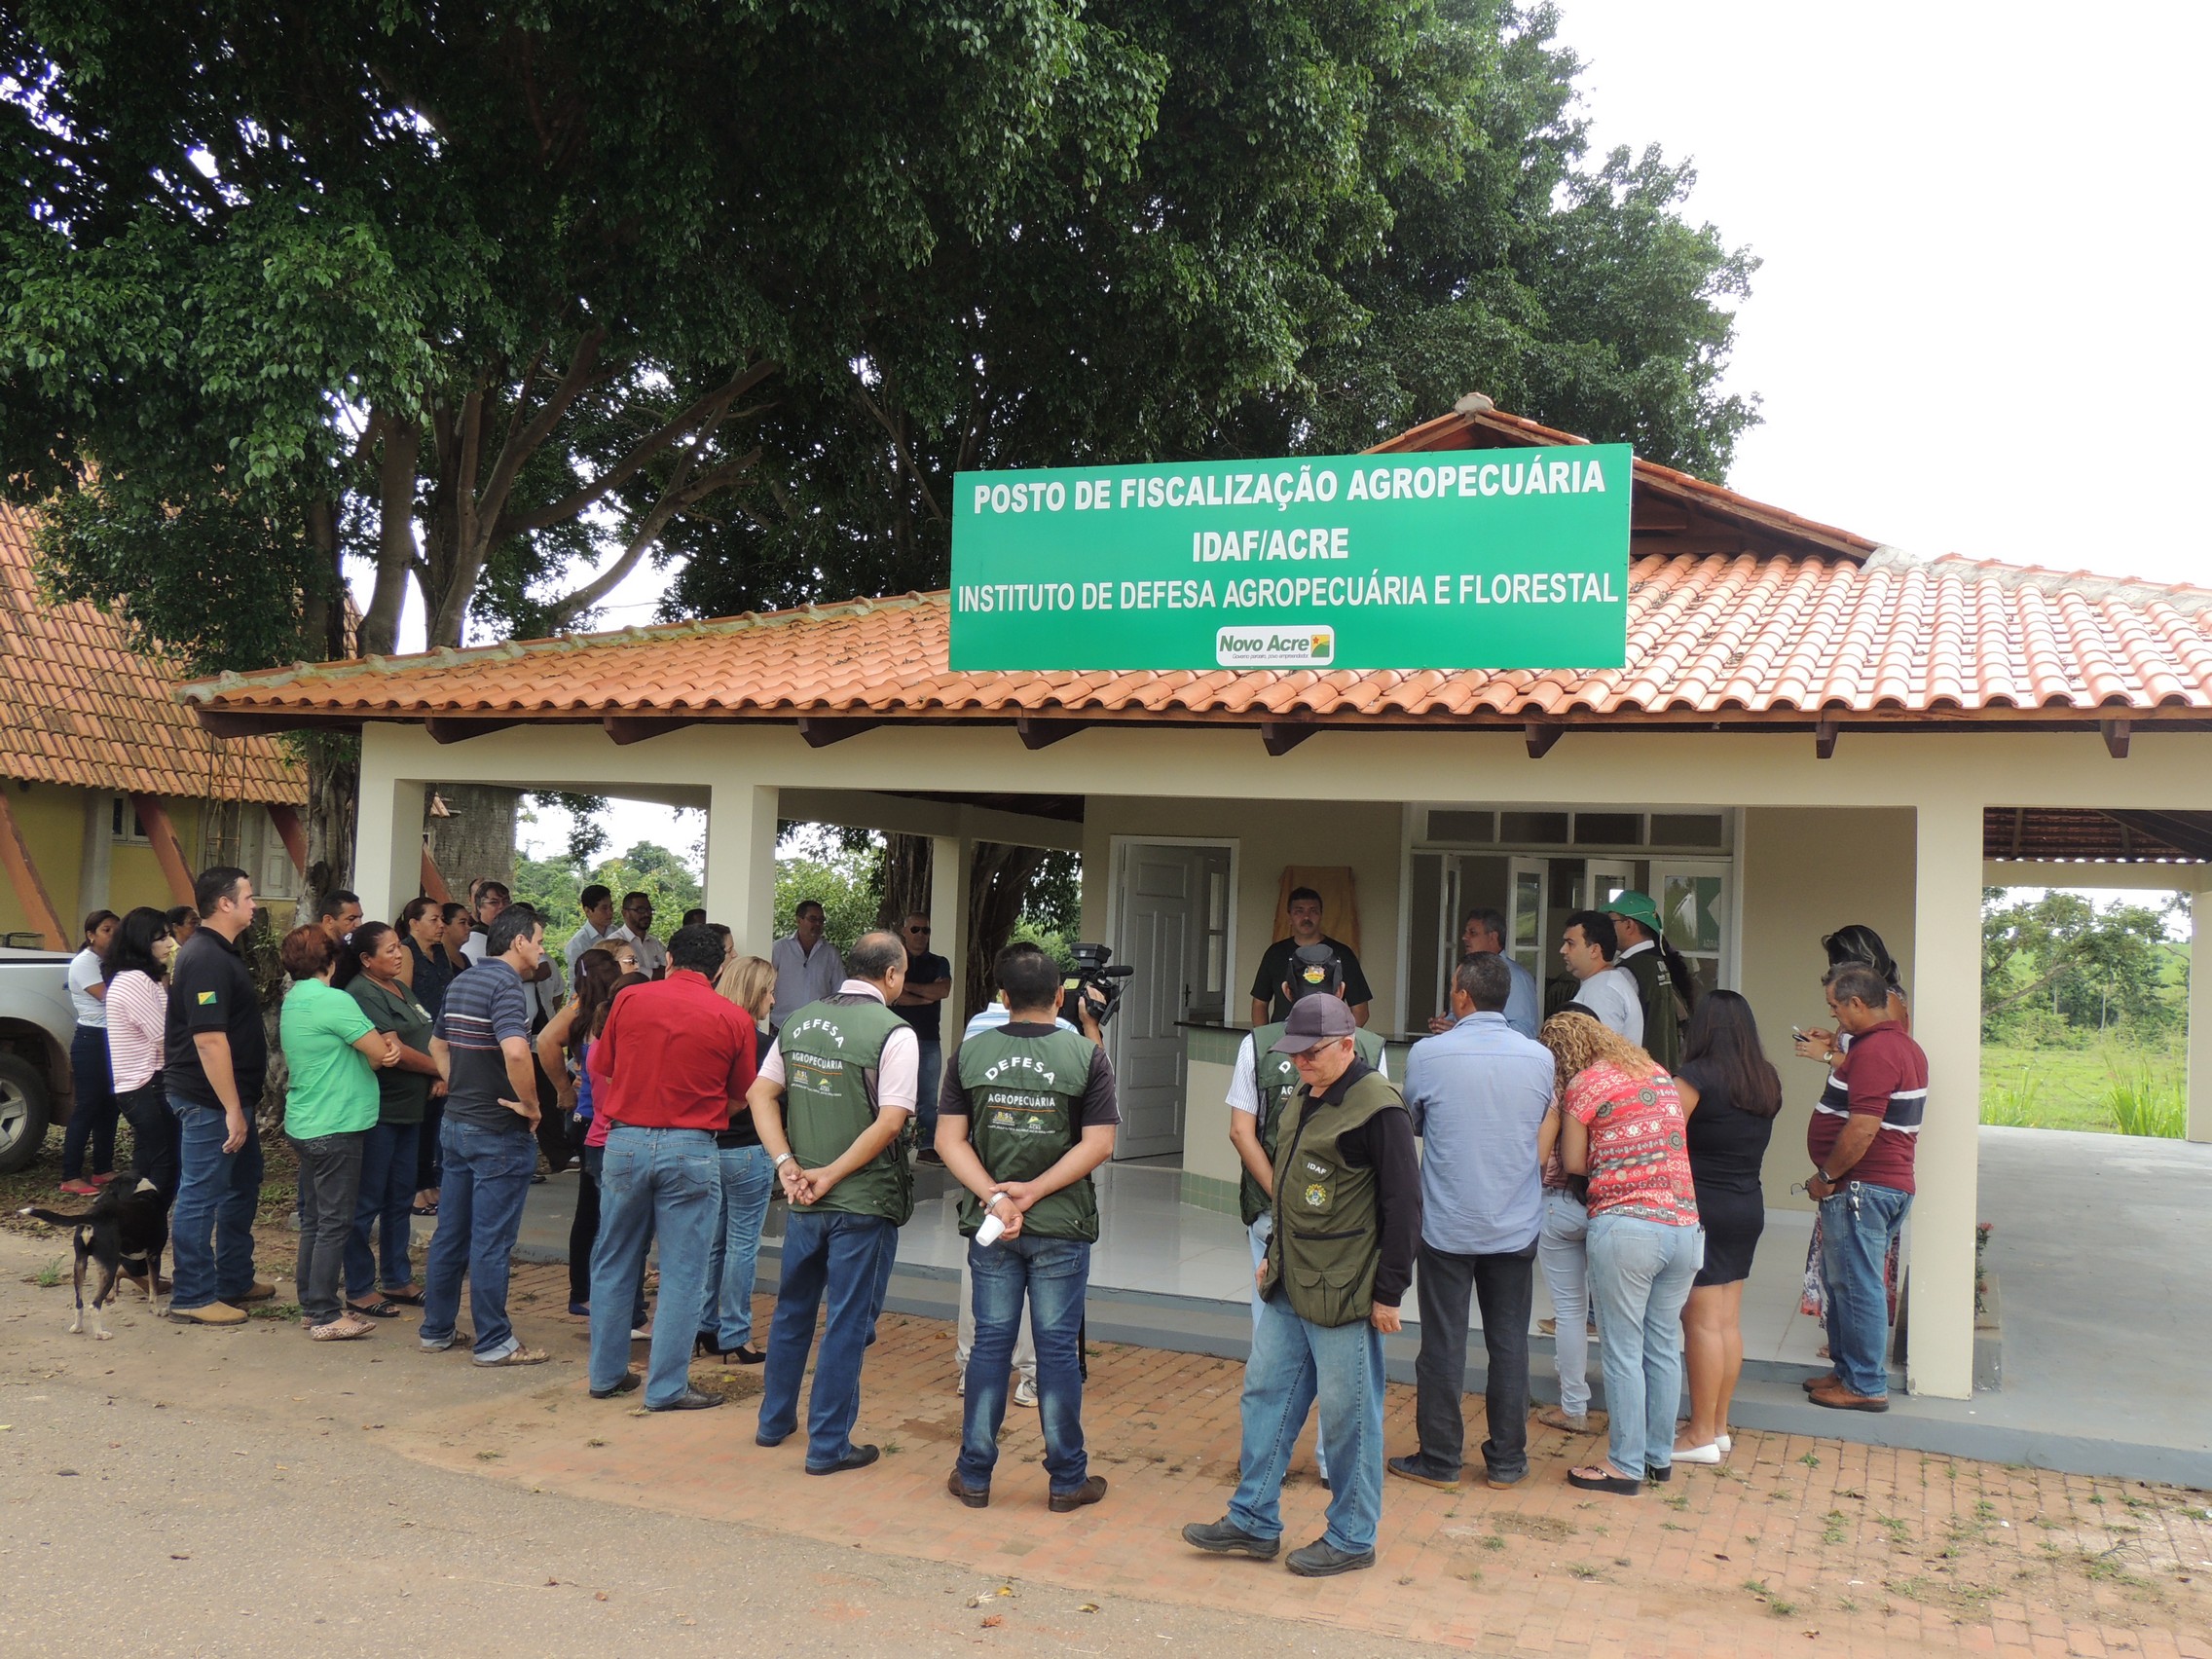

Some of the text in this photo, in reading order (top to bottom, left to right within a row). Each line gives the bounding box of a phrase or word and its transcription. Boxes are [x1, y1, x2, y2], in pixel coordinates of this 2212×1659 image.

[974, 455, 1605, 514] POSTO DE FISCALIZAÇÃO AGROPECUÁRIA
[1193, 528, 1349, 562] IDAF/ACRE
[958, 569, 1619, 612] INSTITUTO DE DEFESA AGROPECUÁRIA E FLORESTAL
[1219, 634, 1309, 651] Novo Acre
[793, 1018, 844, 1049] DEFESA
[792, 1051, 843, 1070] AGROPECUÁRIA
[984, 1056, 1055, 1086] DEFESA
[987, 1092, 1056, 1107] AGROPECUÁRIA
[1307, 1161, 1327, 1175] IDAF
